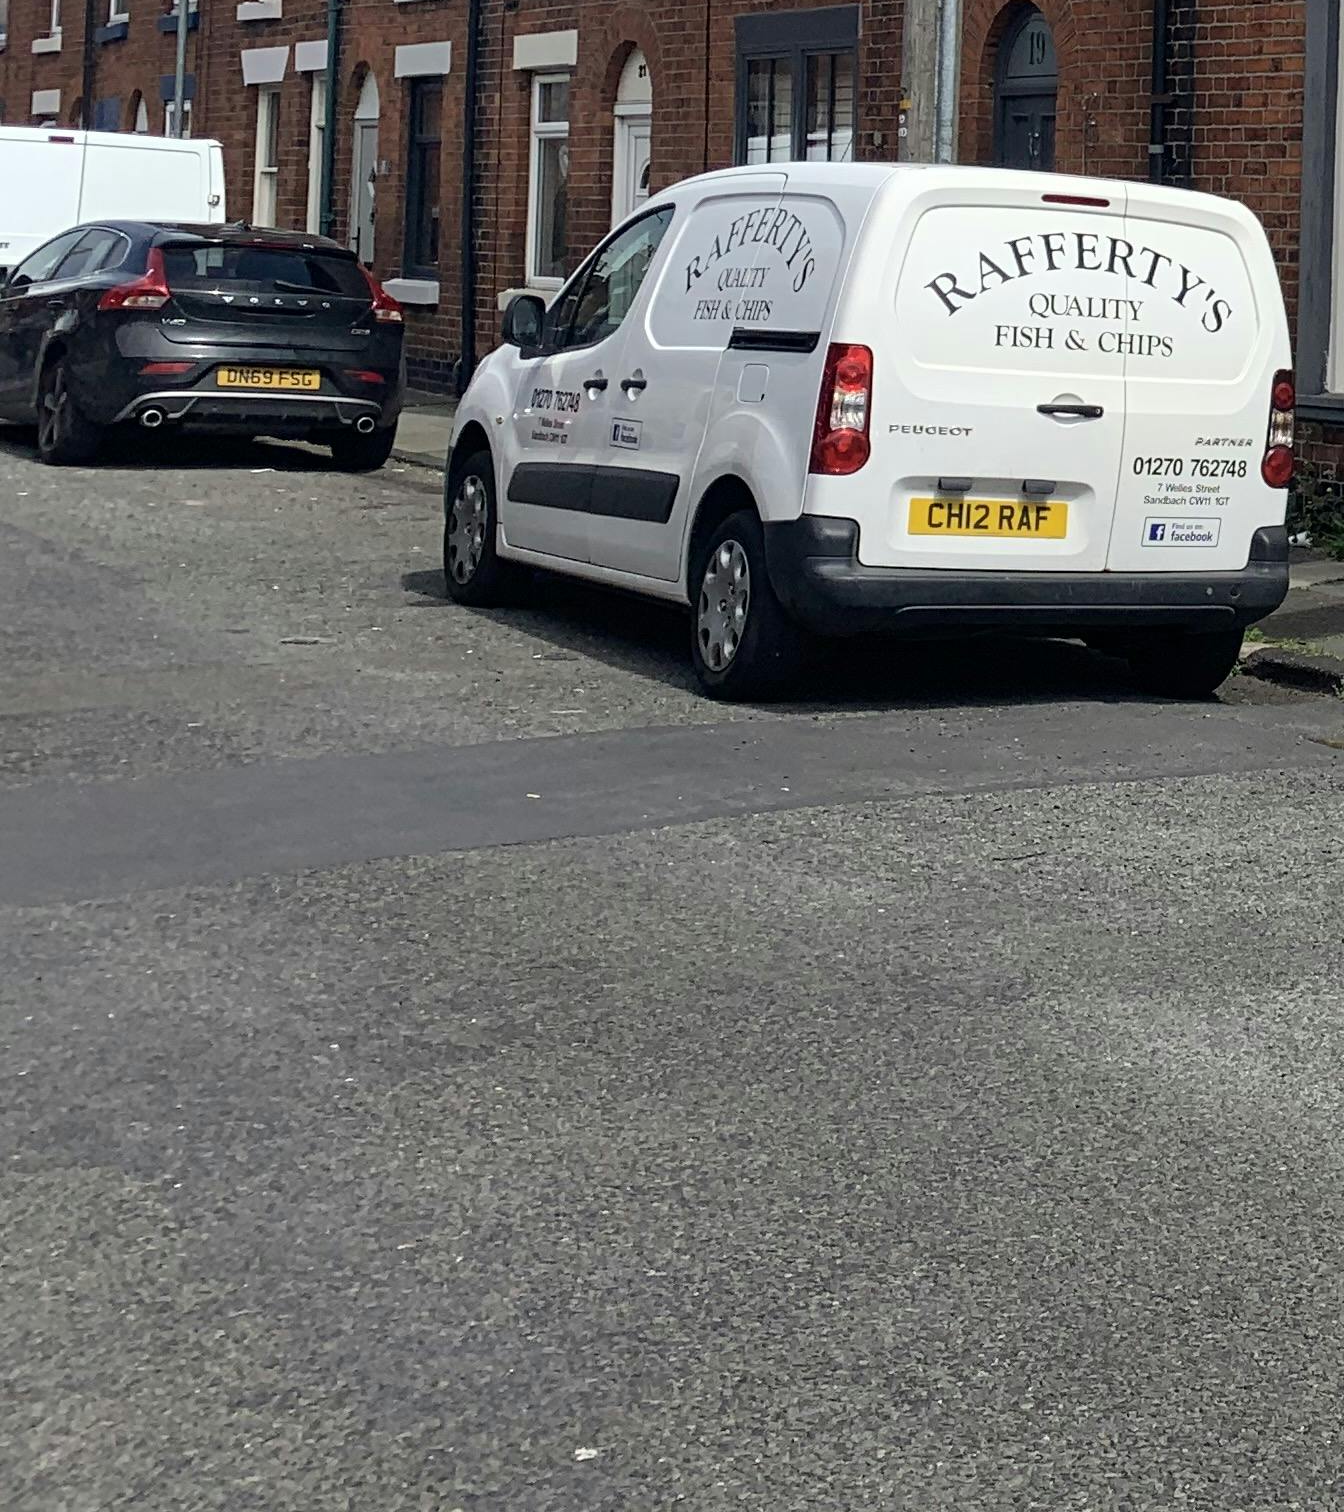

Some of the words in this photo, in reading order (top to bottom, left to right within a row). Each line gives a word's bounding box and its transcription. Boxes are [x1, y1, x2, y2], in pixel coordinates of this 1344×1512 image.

[1029, 31, 1045, 64] 19
[686, 207, 814, 294] RAFFERTY'S
[924, 232, 1232, 333] RAFFERTY'S
[223, 296, 330, 308] VOLVO
[694, 300, 721, 320] FISH
[721, 300, 732, 320] &
[735, 300, 773, 320] CHIPS
[1029, 292, 1144, 321] QUALITY
[995, 325, 1053, 350] FISH
[1065, 330, 1089, 351] &
[1098, 331, 1173, 357] CHIPS
[227, 368, 273, 384] DN69
[279, 370, 312, 386] FSG
[889, 423, 973, 437] PEUGEOT
[1195, 437, 1253, 446] PARTNER
[1133, 457, 1183, 476] 01270
[1191, 459, 1247, 477] 762748
[1158, 483, 1162, 492] 7
[1196, 484, 1220, 493] Street
[1144, 496, 1186, 505] Sandbach
[1189, 497, 1211, 505] CW11
[1215, 497, 1230, 505] 1GT
[928, 504, 988, 530] CH12
[999, 504, 1051, 531] RAF
[1171, 531, 1212, 542] facebook
